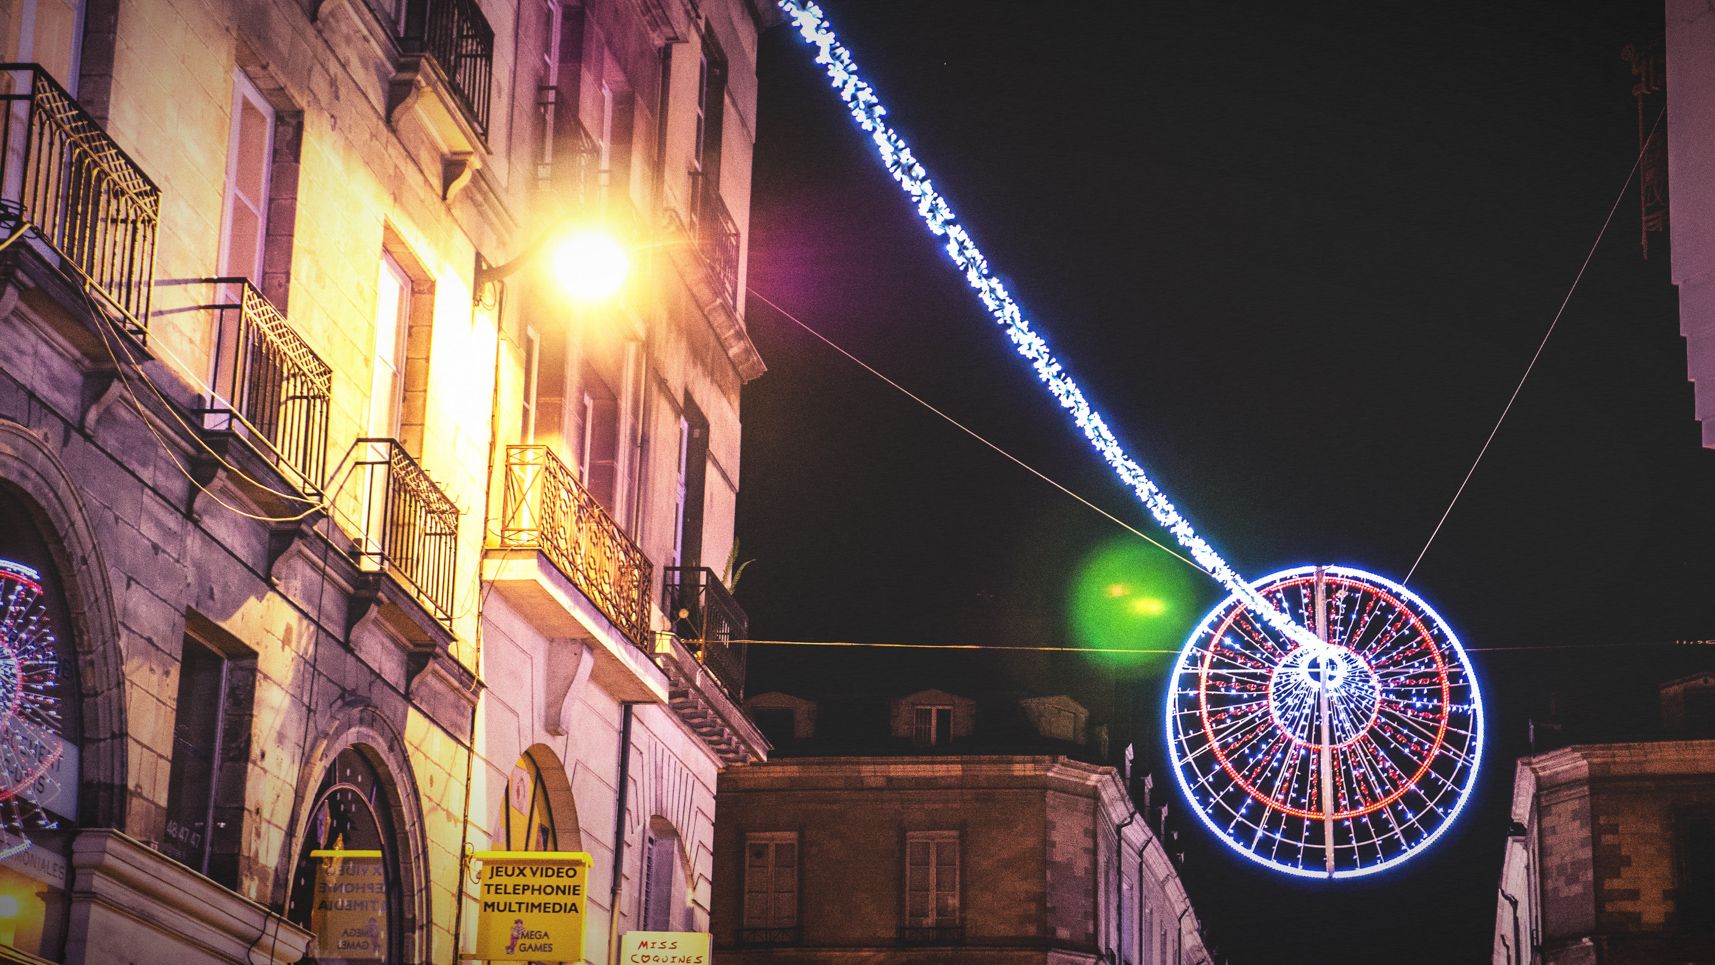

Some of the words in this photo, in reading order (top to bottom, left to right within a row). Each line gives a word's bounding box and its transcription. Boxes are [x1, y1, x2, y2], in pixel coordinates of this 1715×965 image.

[489, 865, 527, 880] JEUX
[529, 866, 577, 879] VIDEO
[484, 883, 581, 896] TELEPHONIE
[483, 901, 579, 914] MULTIMEDIA
[520, 930, 550, 940] MEGA
[519, 943, 553, 952] GAMES
[637, 940, 678, 950] MISS
